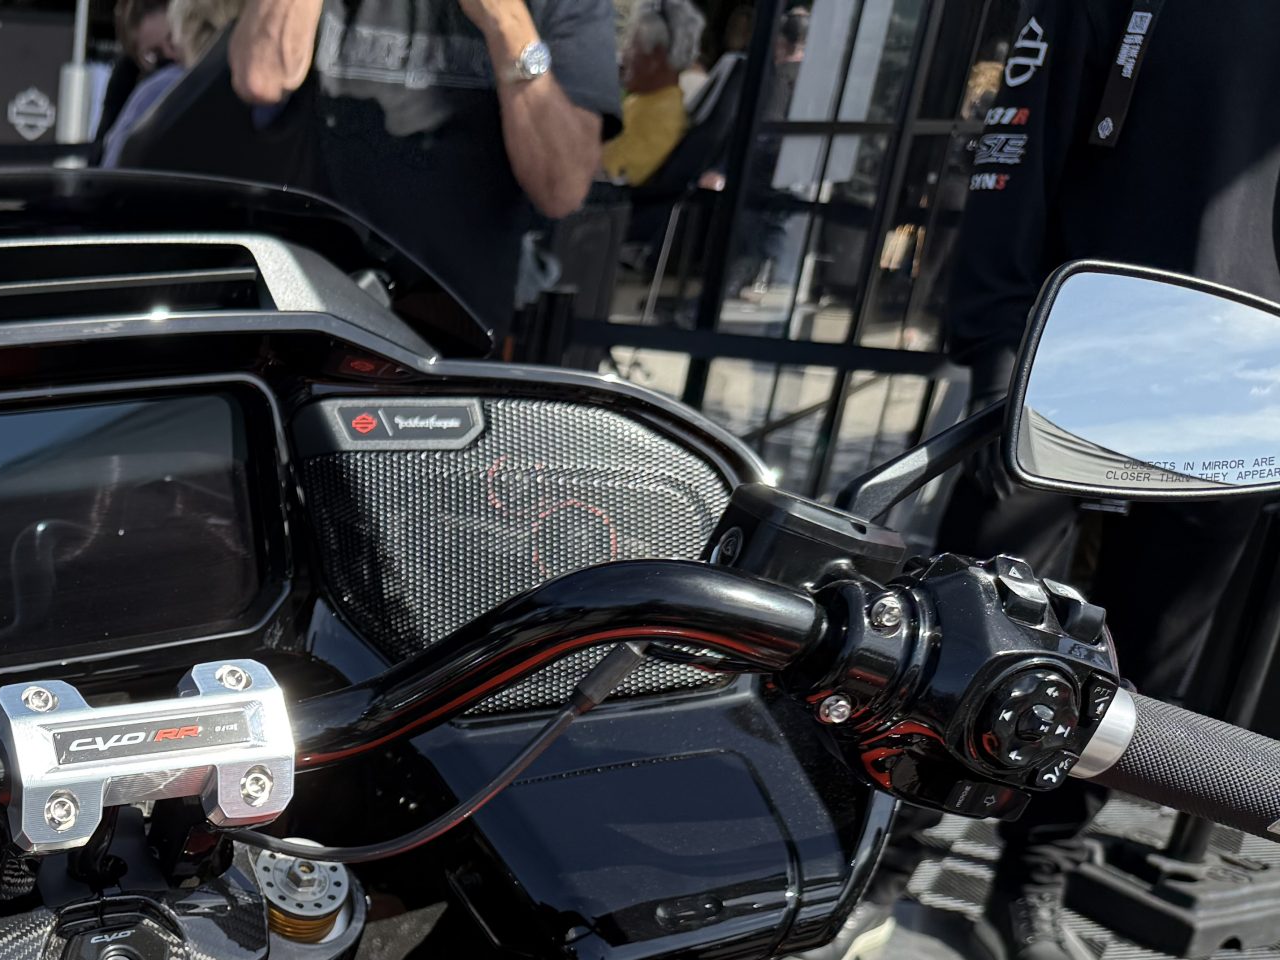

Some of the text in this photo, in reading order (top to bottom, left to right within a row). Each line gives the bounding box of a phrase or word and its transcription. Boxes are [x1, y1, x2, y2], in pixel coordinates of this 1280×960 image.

[1123, 456, 1276, 472] OBJECTS IN MIRROR ARE
[1105, 470, 1151, 482] CLOSER
[1159, 472, 1192, 483] THAN
[1199, 472, 1229, 482] THEY
